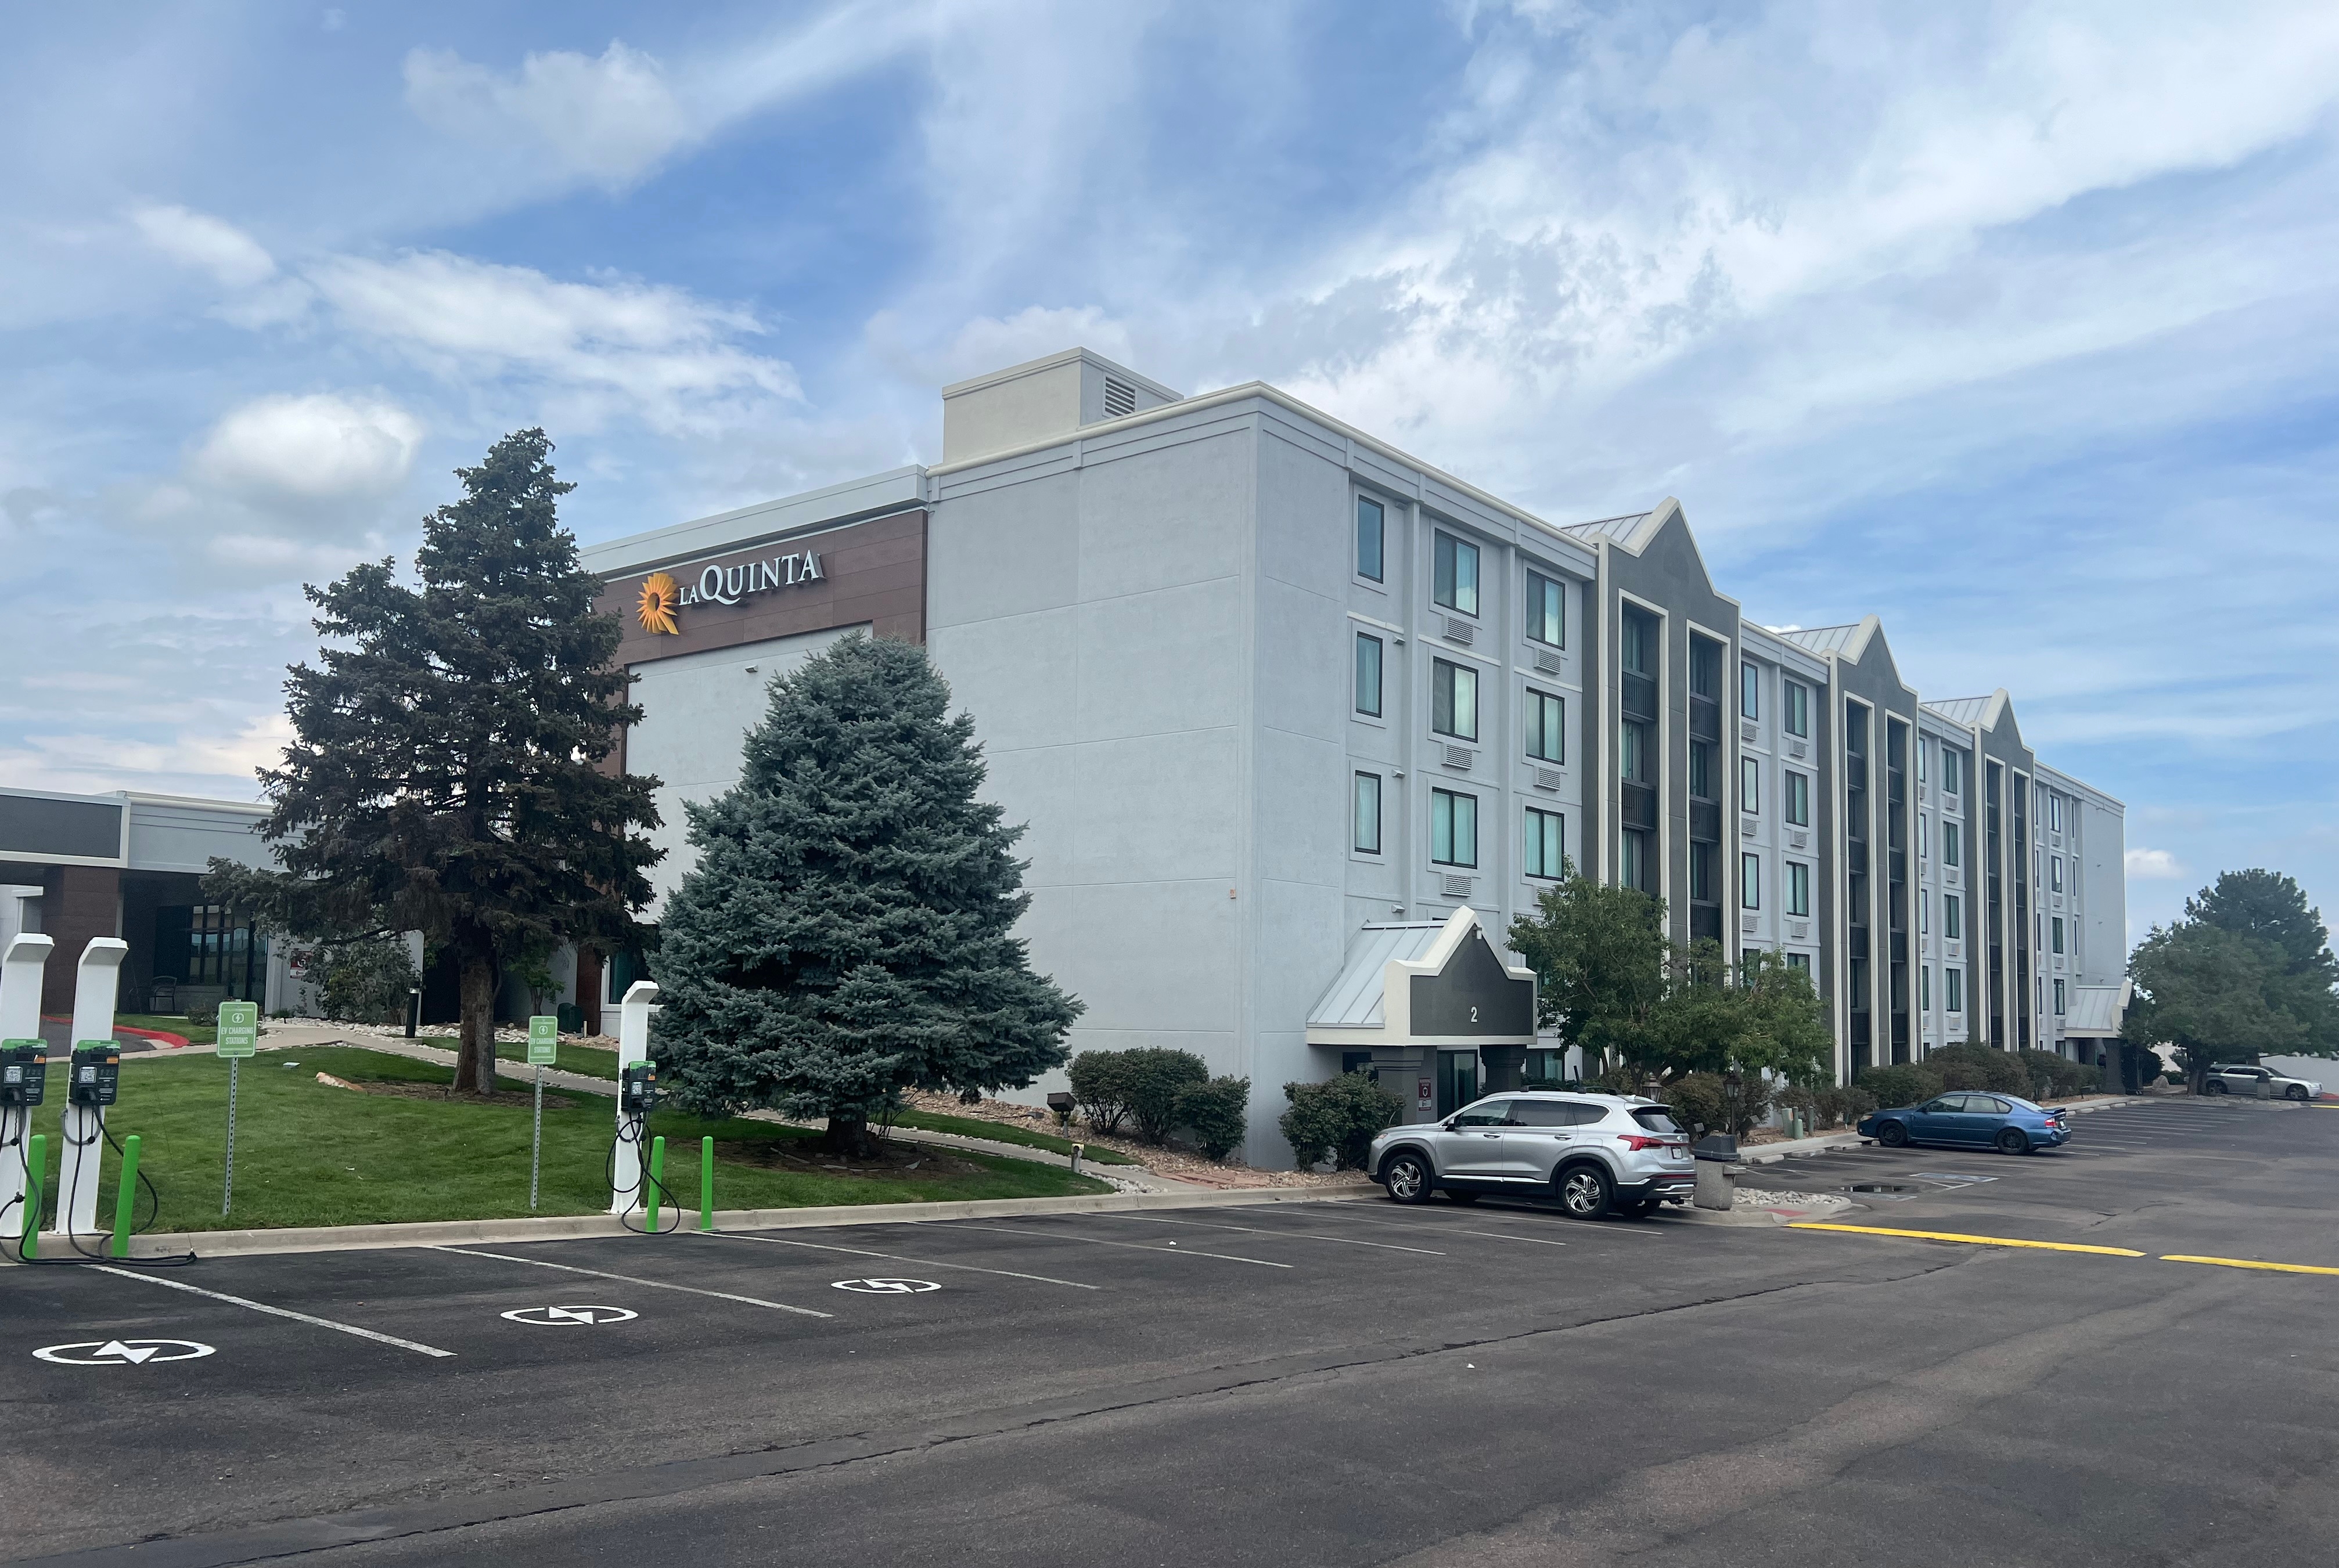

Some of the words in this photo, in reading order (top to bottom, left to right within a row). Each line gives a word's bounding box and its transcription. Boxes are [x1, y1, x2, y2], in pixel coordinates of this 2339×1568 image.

[678, 585, 700, 606] LA
[699, 549, 819, 605] QUINTA
[1471, 1006, 1478, 1022] 2
[221, 1027, 228, 1035] EV
